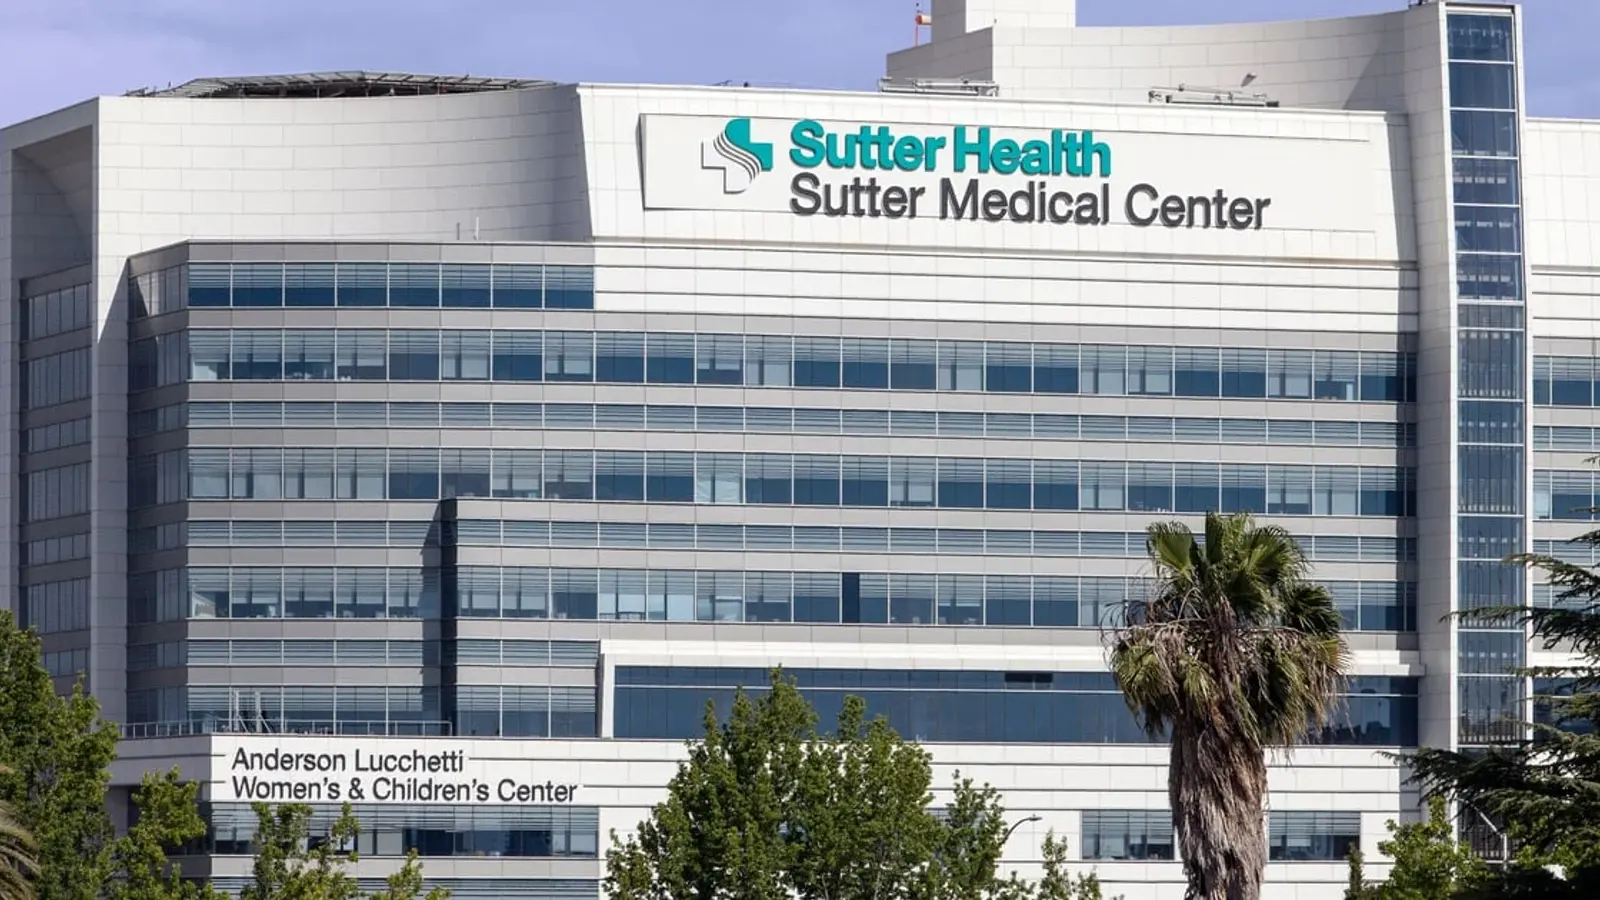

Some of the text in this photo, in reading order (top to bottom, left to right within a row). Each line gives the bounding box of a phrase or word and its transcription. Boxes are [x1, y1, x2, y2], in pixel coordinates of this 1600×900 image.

[789, 119, 1112, 177] Sutter Health
[789, 172, 1271, 230] Sutter Medical Center
[231, 747, 464, 773] Anderson Lucchetti
[232, 776, 578, 802] Women's & Children's Center
